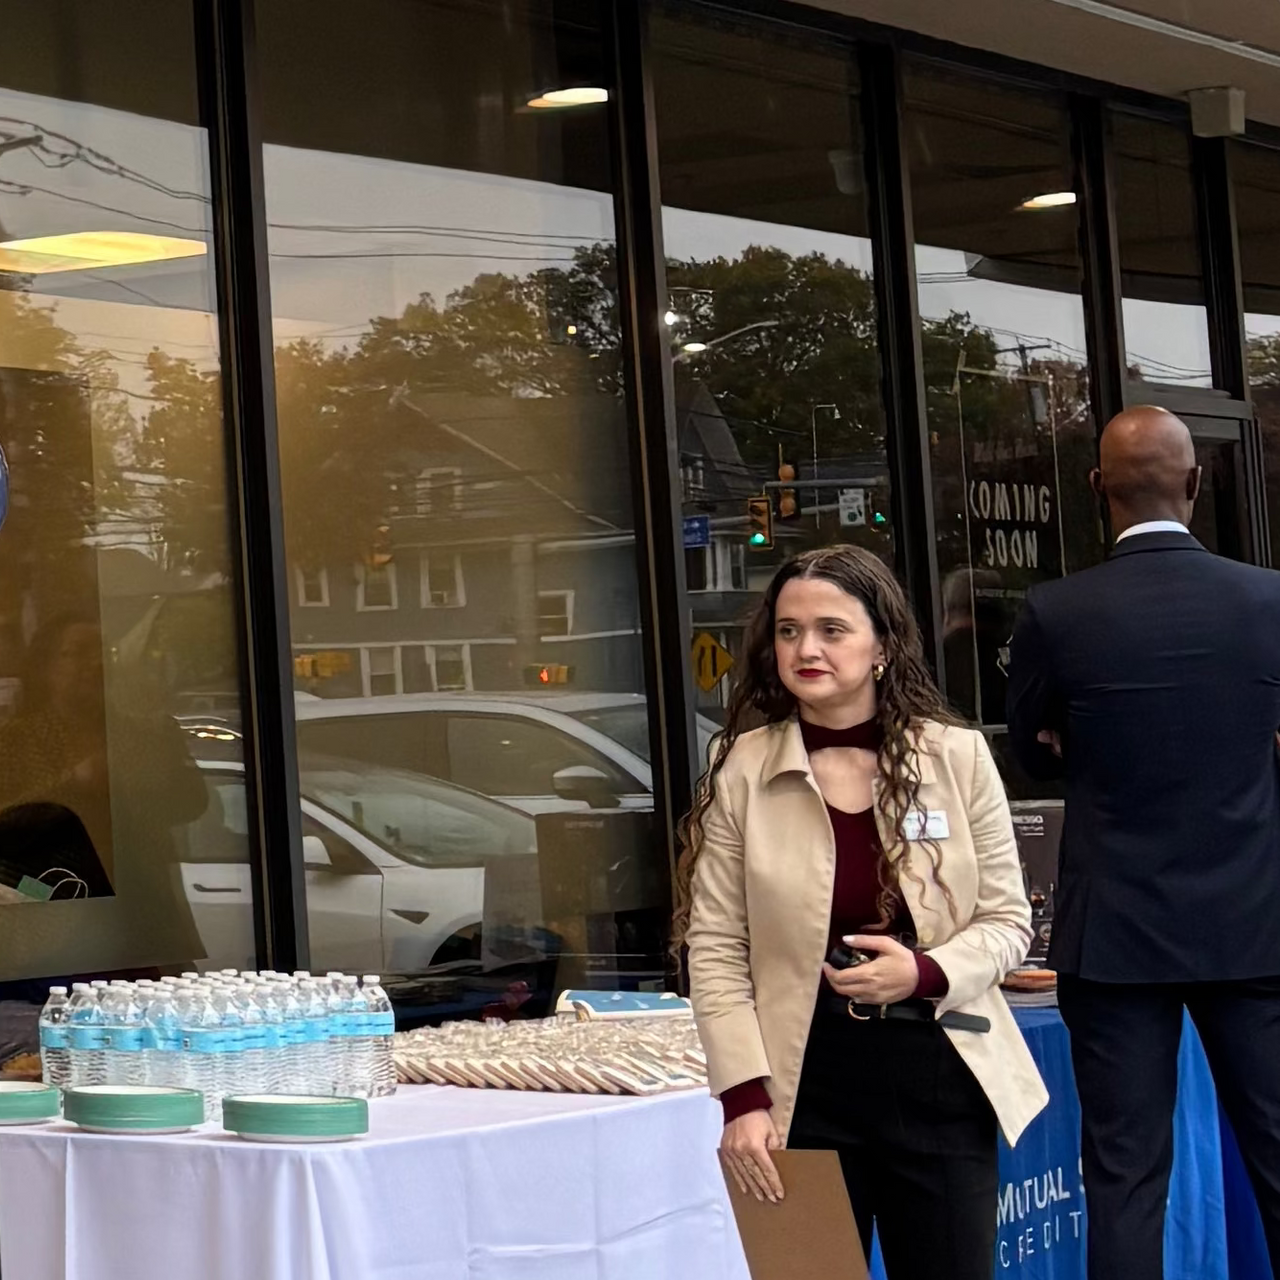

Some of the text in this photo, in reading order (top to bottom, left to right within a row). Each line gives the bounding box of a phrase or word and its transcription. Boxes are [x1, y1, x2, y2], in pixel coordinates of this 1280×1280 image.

[969, 479, 1050, 523] COMING
[984, 527, 1038, 568] SOON
[997, 1166, 1070, 1228] MUTUAL
